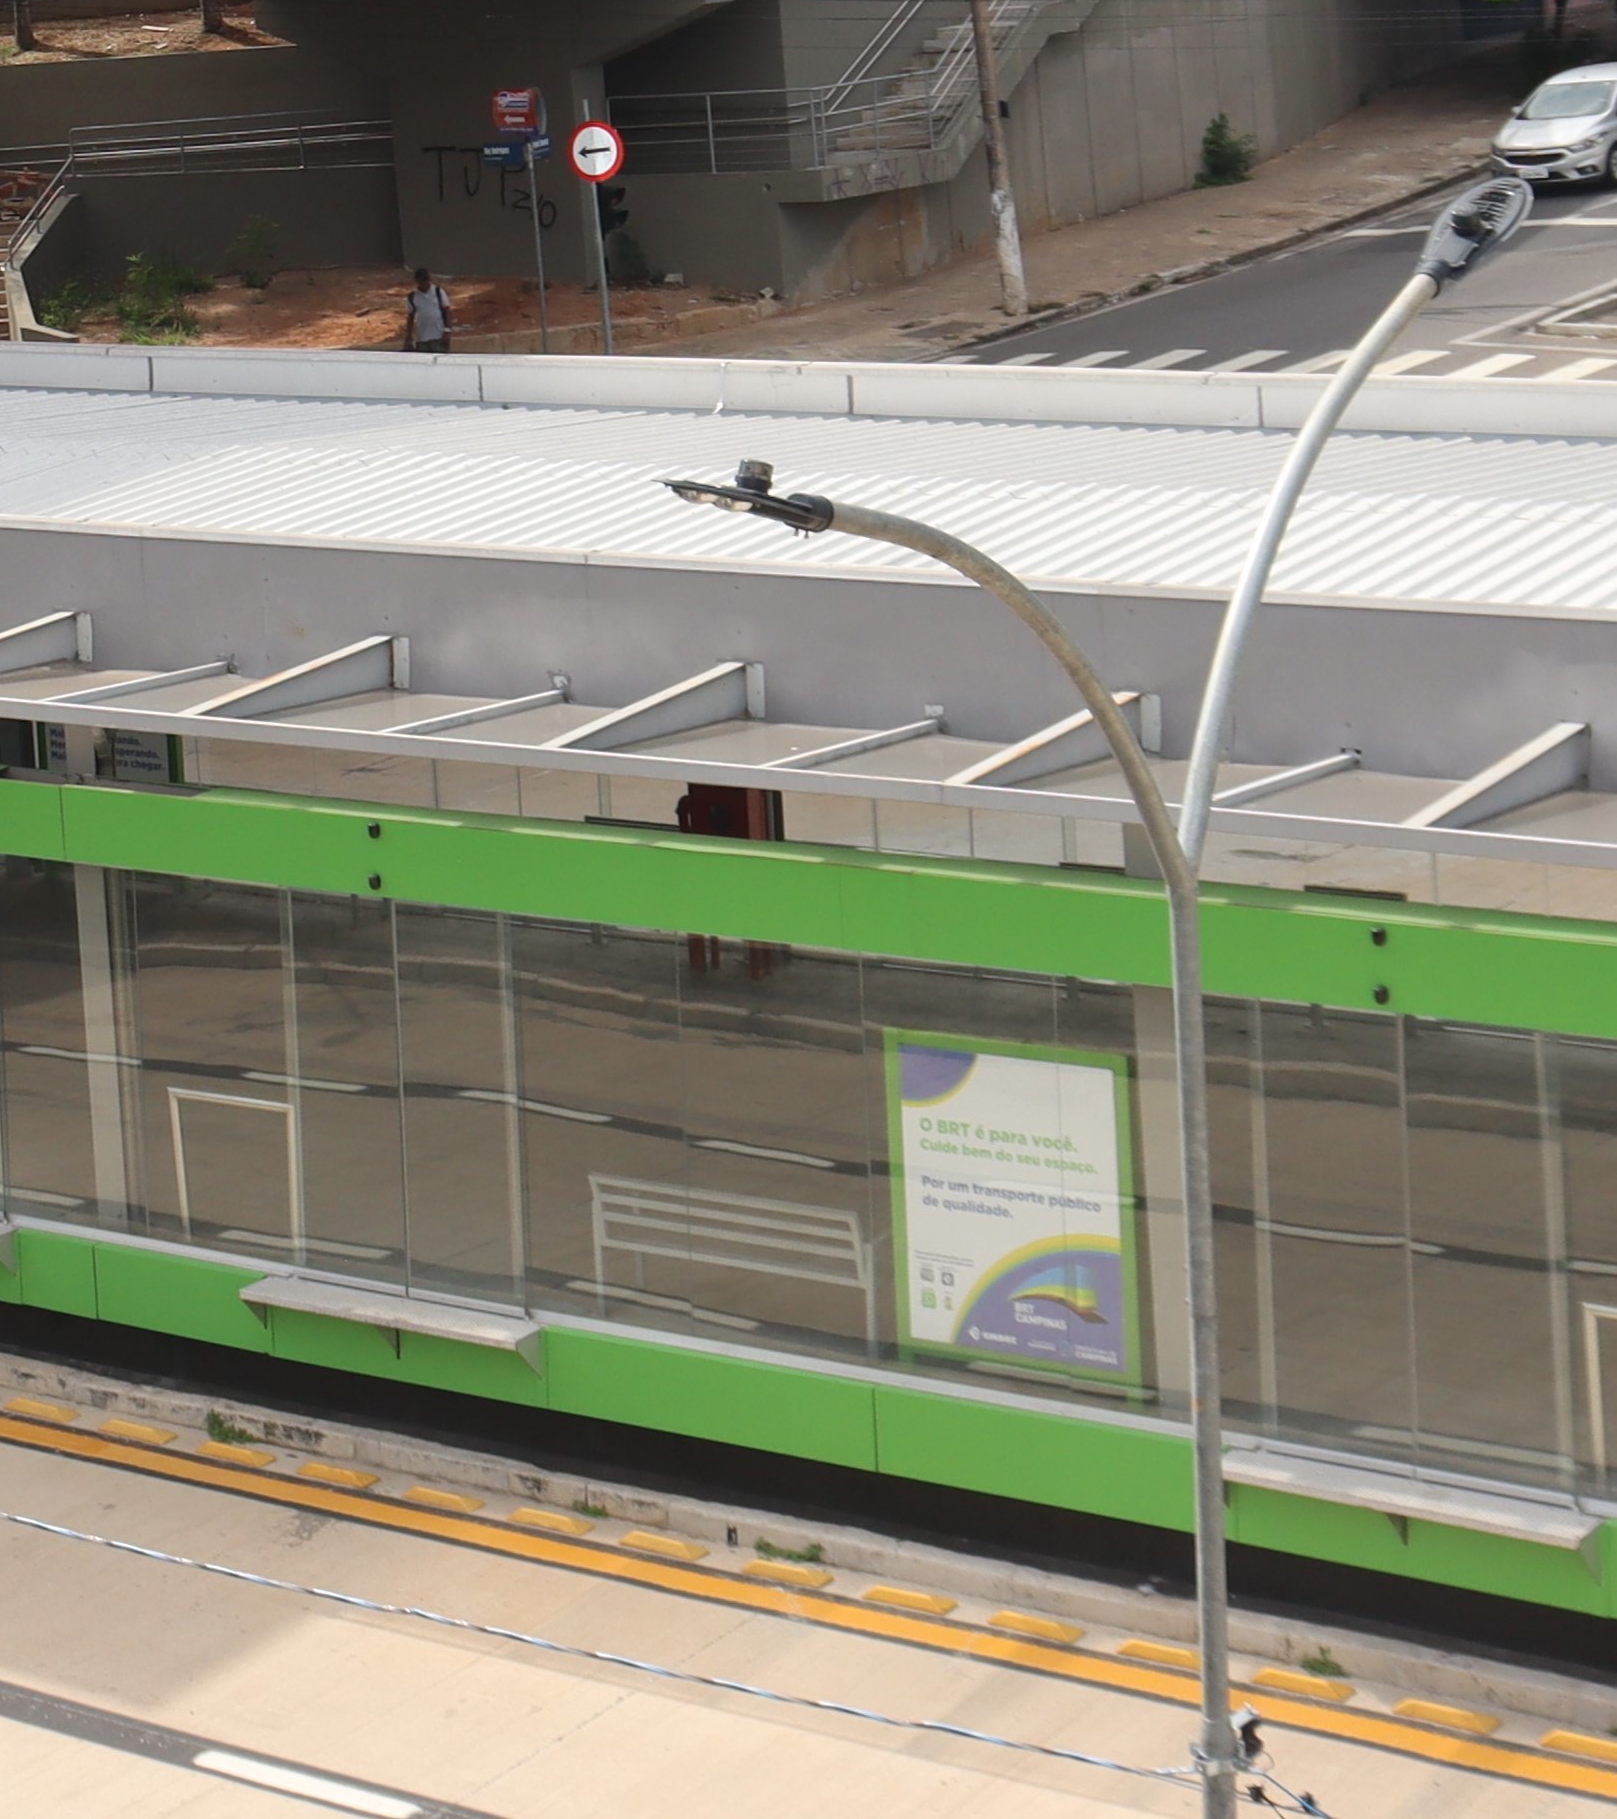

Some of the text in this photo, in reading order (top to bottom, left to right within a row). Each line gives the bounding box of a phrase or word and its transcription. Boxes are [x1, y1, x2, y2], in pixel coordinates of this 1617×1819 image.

[920, 1117, 1078, 1153] O BRT é para você.
[920, 1138, 1098, 1174] Cuide bem do seu espaço.
[921, 1174, 1102, 1213] Por um transporte público
[922, 1195, 1014, 1219] de qualidade.
[1015, 1302, 1035, 1314] BRT
[1015, 1314, 1068, 1331] CAMPINAS
